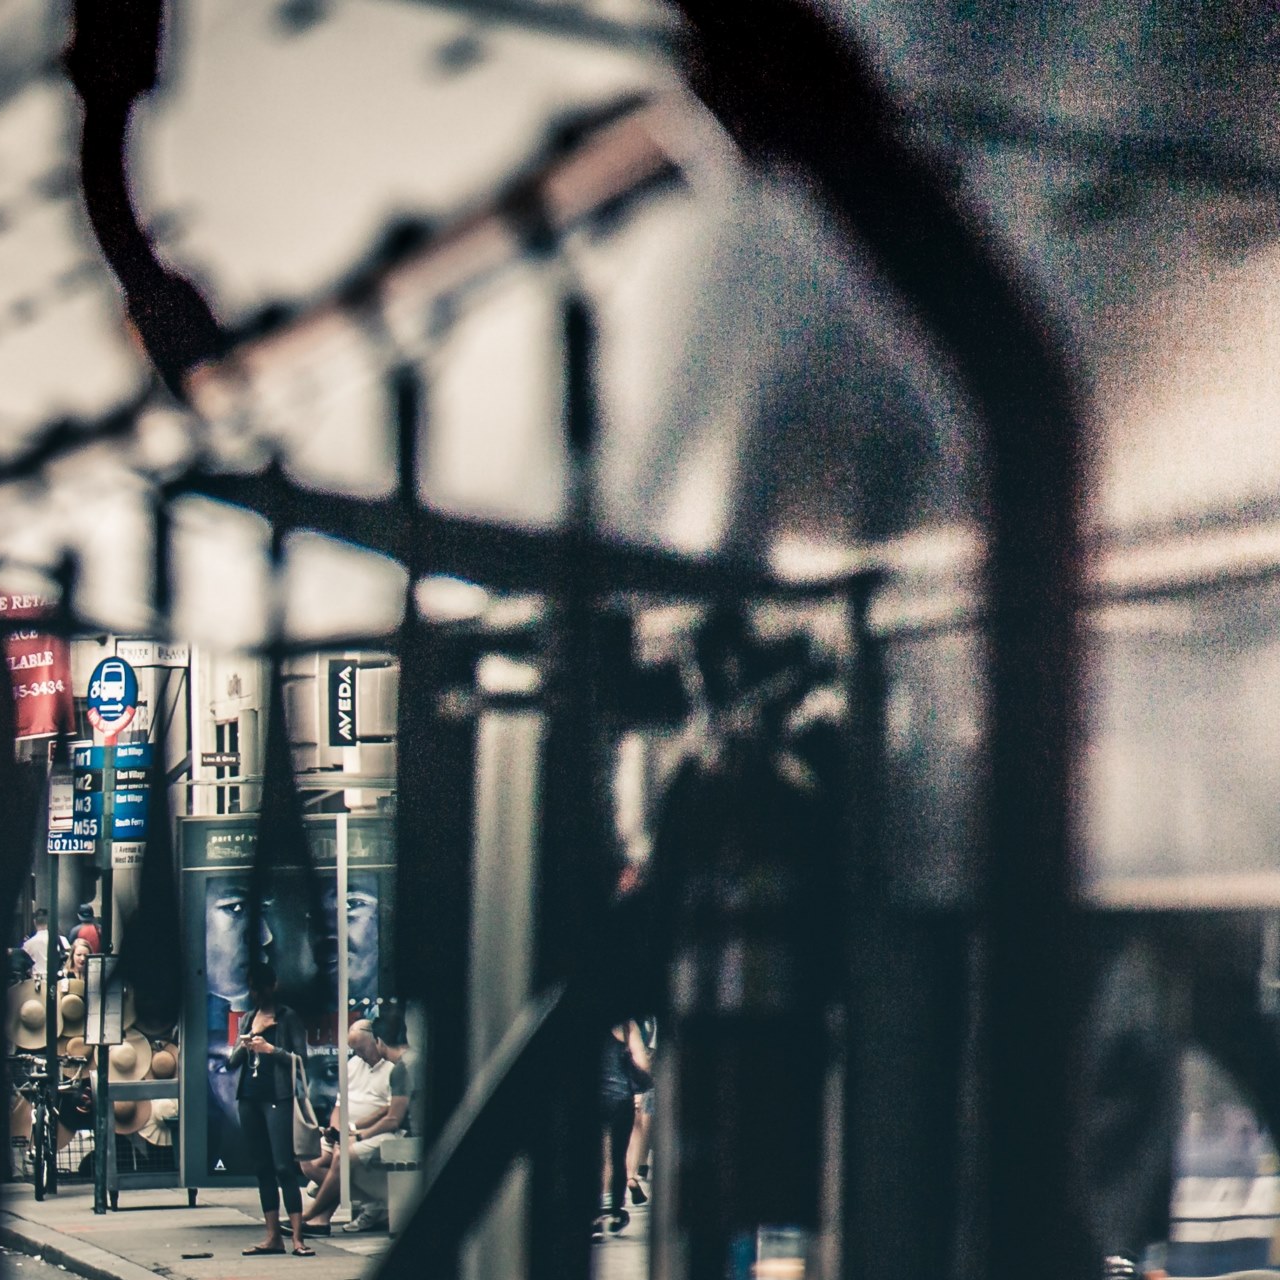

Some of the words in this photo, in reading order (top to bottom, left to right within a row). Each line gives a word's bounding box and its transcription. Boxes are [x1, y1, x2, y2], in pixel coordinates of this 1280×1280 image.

[10, 651, 53, 670] LABLE
[338, 666, 352, 740] AVEDA
[76, 749, 92, 767] M1
[128, 747, 144, 757] Village
[76, 773, 93, 791] M2
[128, 770, 146, 780] Village
[75, 796, 92, 812] M3
[127, 794, 143, 803] Village
[73, 819, 98, 836] M55
[115, 818, 130, 828] South
[131, 818, 144, 827] Ferry
[211, 835, 232, 843] part
[235, 834, 245, 842] of
